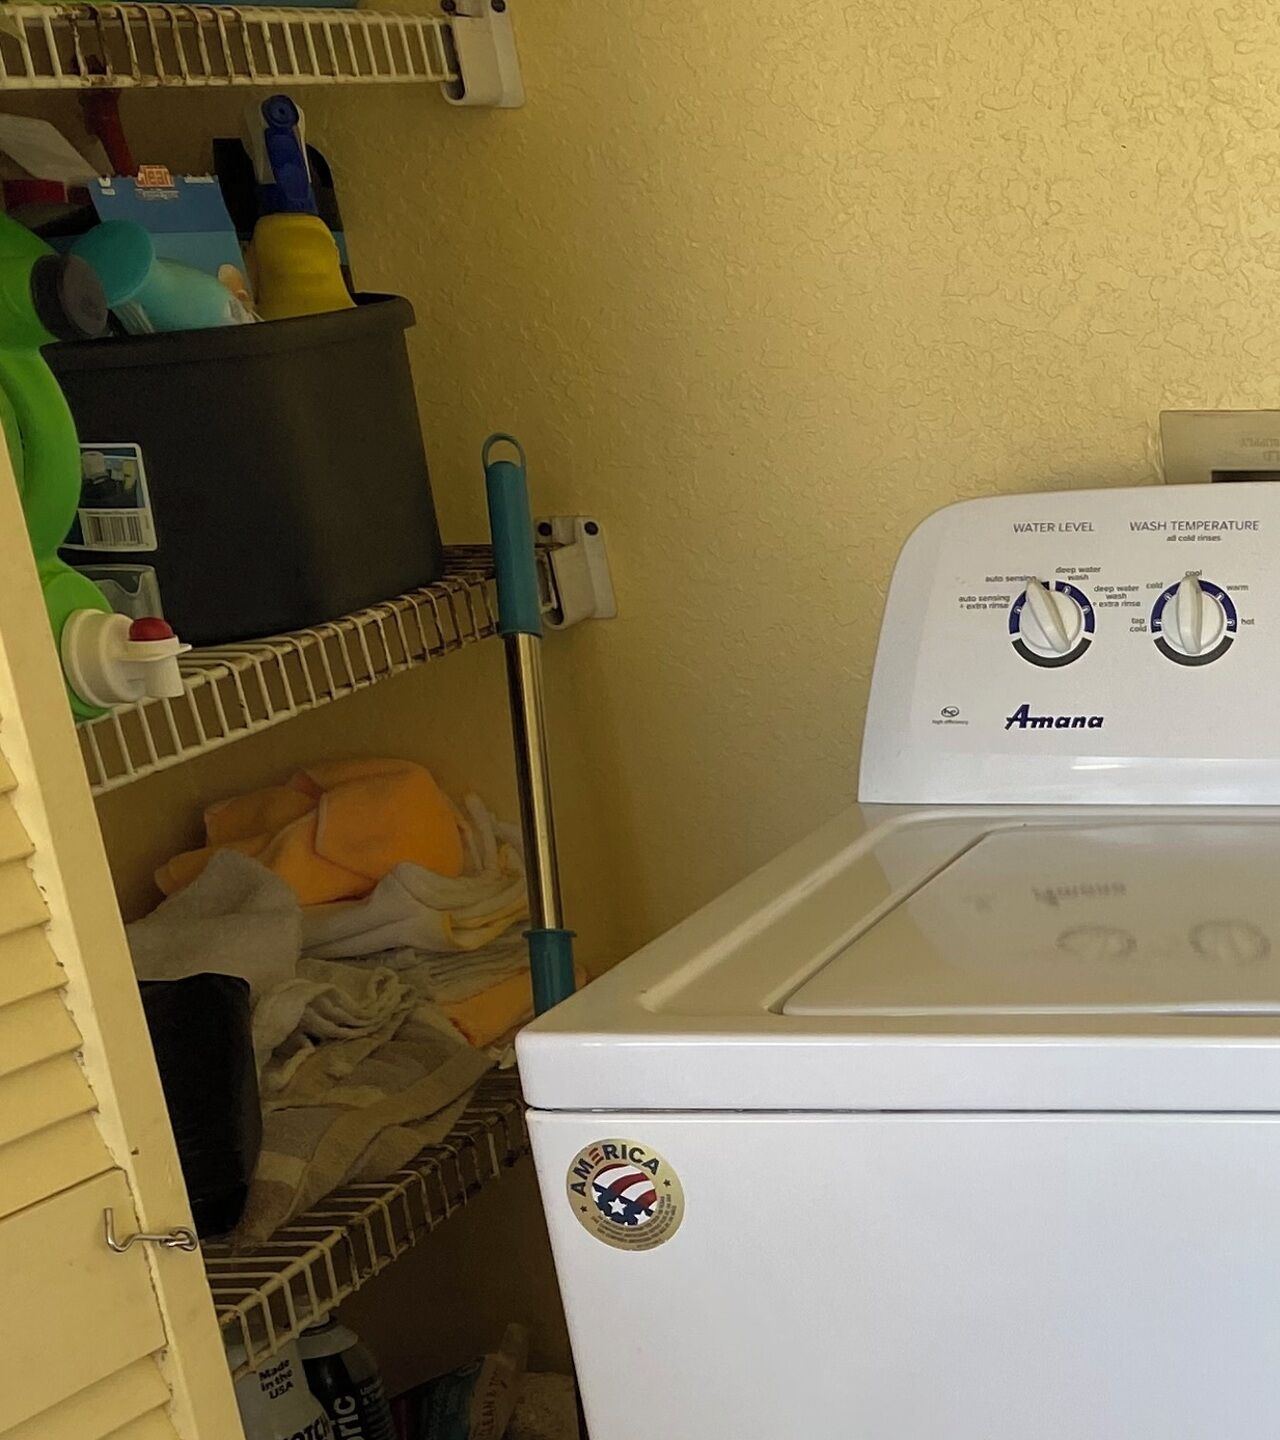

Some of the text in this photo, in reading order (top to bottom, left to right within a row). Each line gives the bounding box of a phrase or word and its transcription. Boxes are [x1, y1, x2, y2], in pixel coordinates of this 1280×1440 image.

[1014, 522, 1094, 533] WATER LEVEL
[1130, 521, 1259, 531] WASH TEMPERATURE
[1055, 567, 1101, 576] deep water
[1068, 572, 1089, 580] wash
[1094, 585, 1115, 595] deep
[1105, 591, 1127, 599] wash
[979, 594, 1010, 605] sensing
[1131, 618, 1146, 627] tap
[1130, 624, 1147, 632] cold
[1005, 704, 1104, 730] Amana
[570, 1144, 660, 1197] AMERICA
[259, 1360, 290, 1381] Made
[261, 1369, 293, 1392] in the
[269, 1381, 294, 1399] USA
